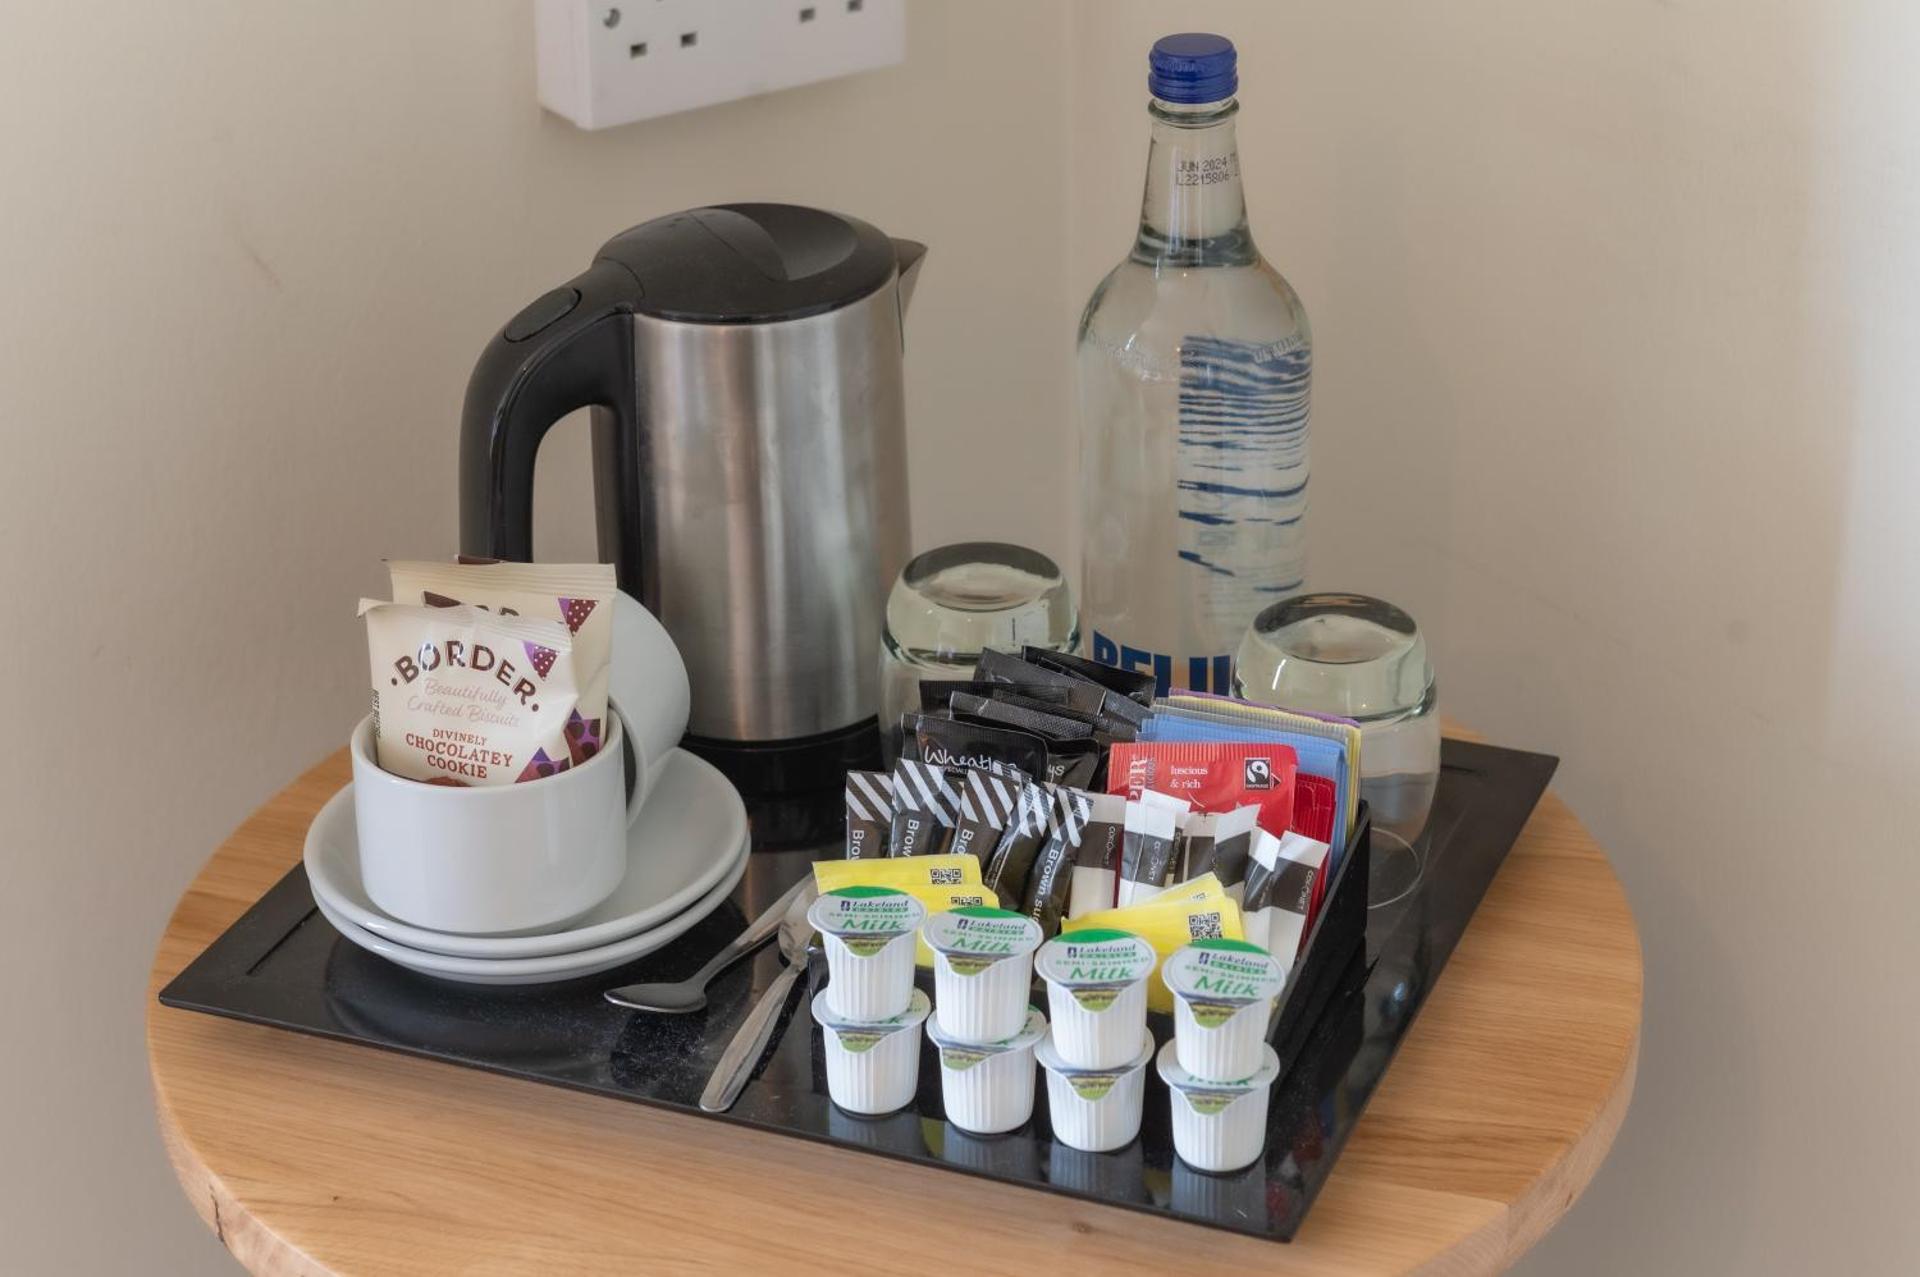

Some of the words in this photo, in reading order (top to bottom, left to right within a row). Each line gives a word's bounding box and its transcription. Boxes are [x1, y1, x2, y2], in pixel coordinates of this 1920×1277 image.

[1176, 161, 1199, 172] JUN
[1202, 157, 1227, 172] 2024
[395, 640, 537, 706] BORDER
[424, 676, 508, 711] Beautifully
[407, 695, 462, 717] Crafted
[466, 704, 520, 728] Biscuits
[432, 727, 488, 746] DIVINELY
[405, 733, 514, 768] CHOCOLATEY
[427, 755, 488, 780] COOKIE
[1170, 765, 1208, 775] luscious
[1182, 779, 1201, 788] rich
[902, 819, 919, 857] Brow
[956, 829, 974, 855] Bro
[1037, 847, 1060, 896] Brown
[842, 918, 906, 931] Milk
[952, 937, 1011, 952] Milk
[1071, 967, 1133, 980] Milk
[1194, 975, 1260, 996] Milk
